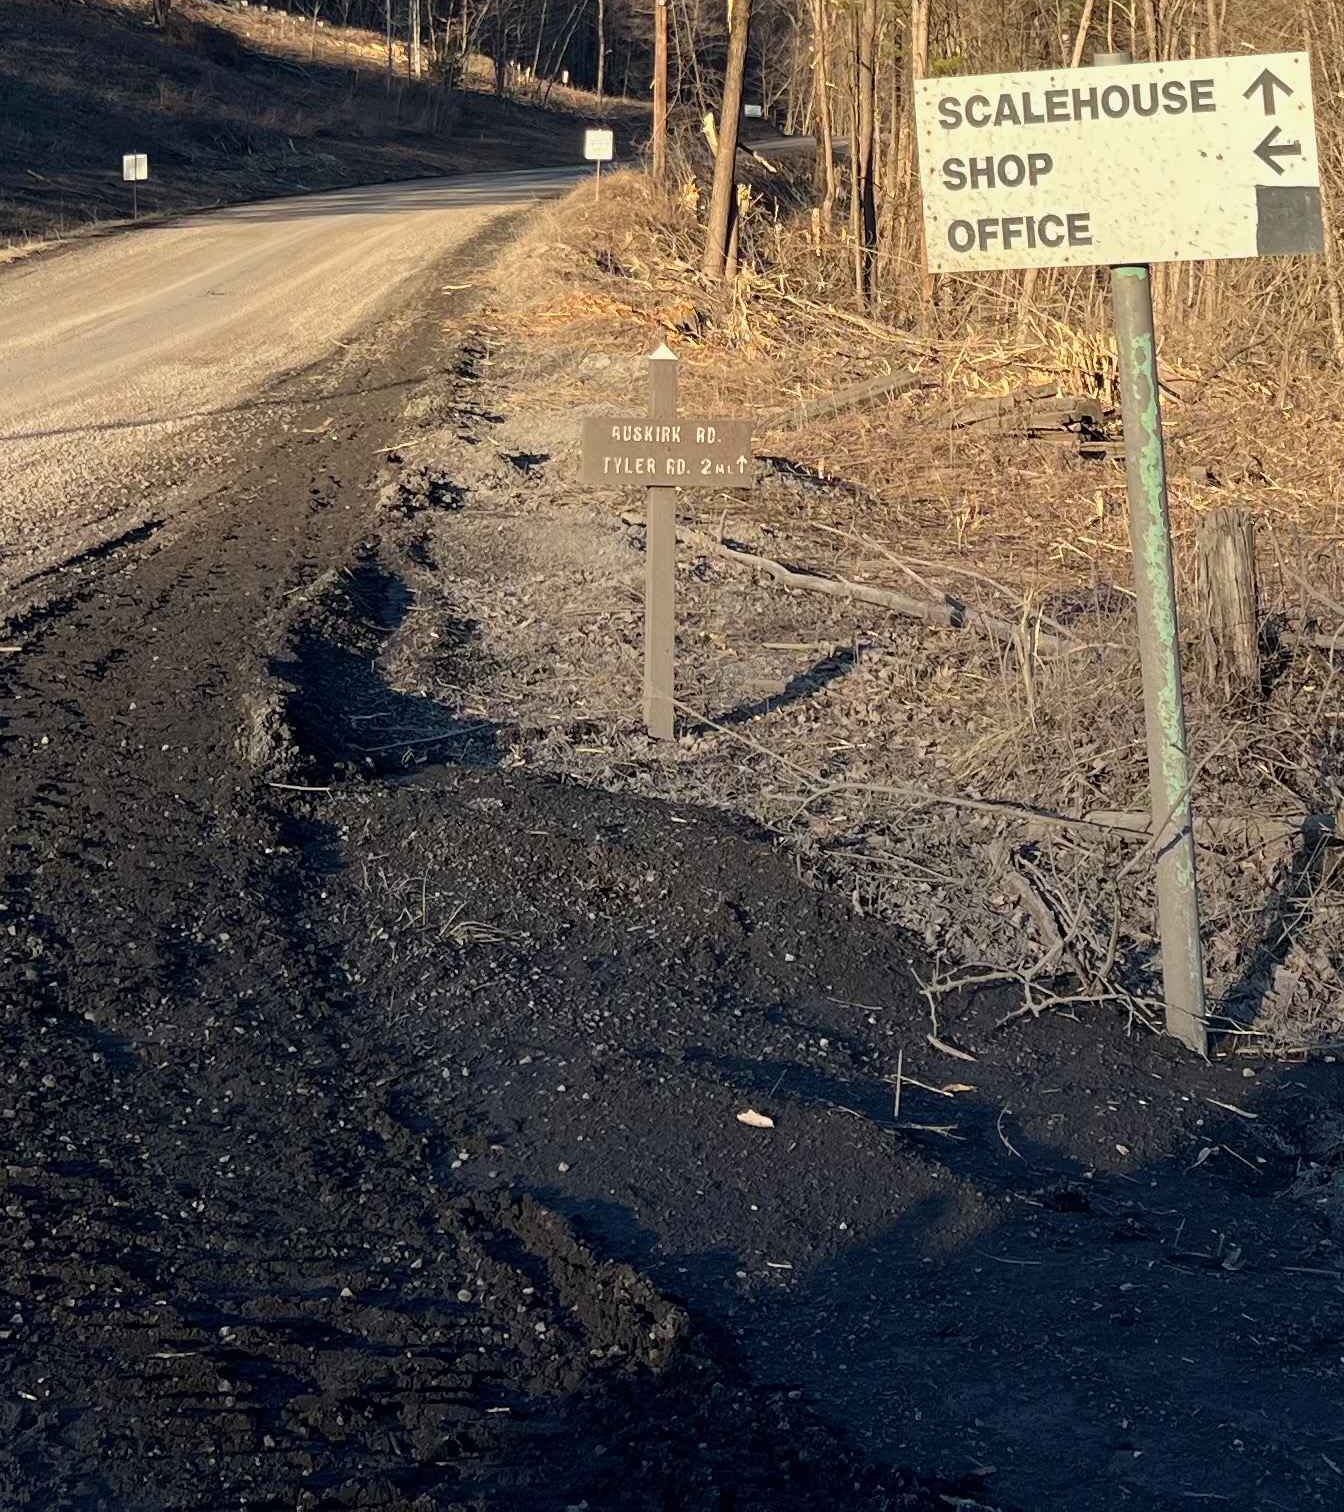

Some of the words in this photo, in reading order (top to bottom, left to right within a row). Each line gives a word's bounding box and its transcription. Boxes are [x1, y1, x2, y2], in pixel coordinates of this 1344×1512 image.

[938, 79, 1217, 130] SCALEHOUSE
[942, 152, 1054, 191] SHOP
[947, 212, 1093, 253] OFFICE
[602, 456, 656, 475] TYLER
